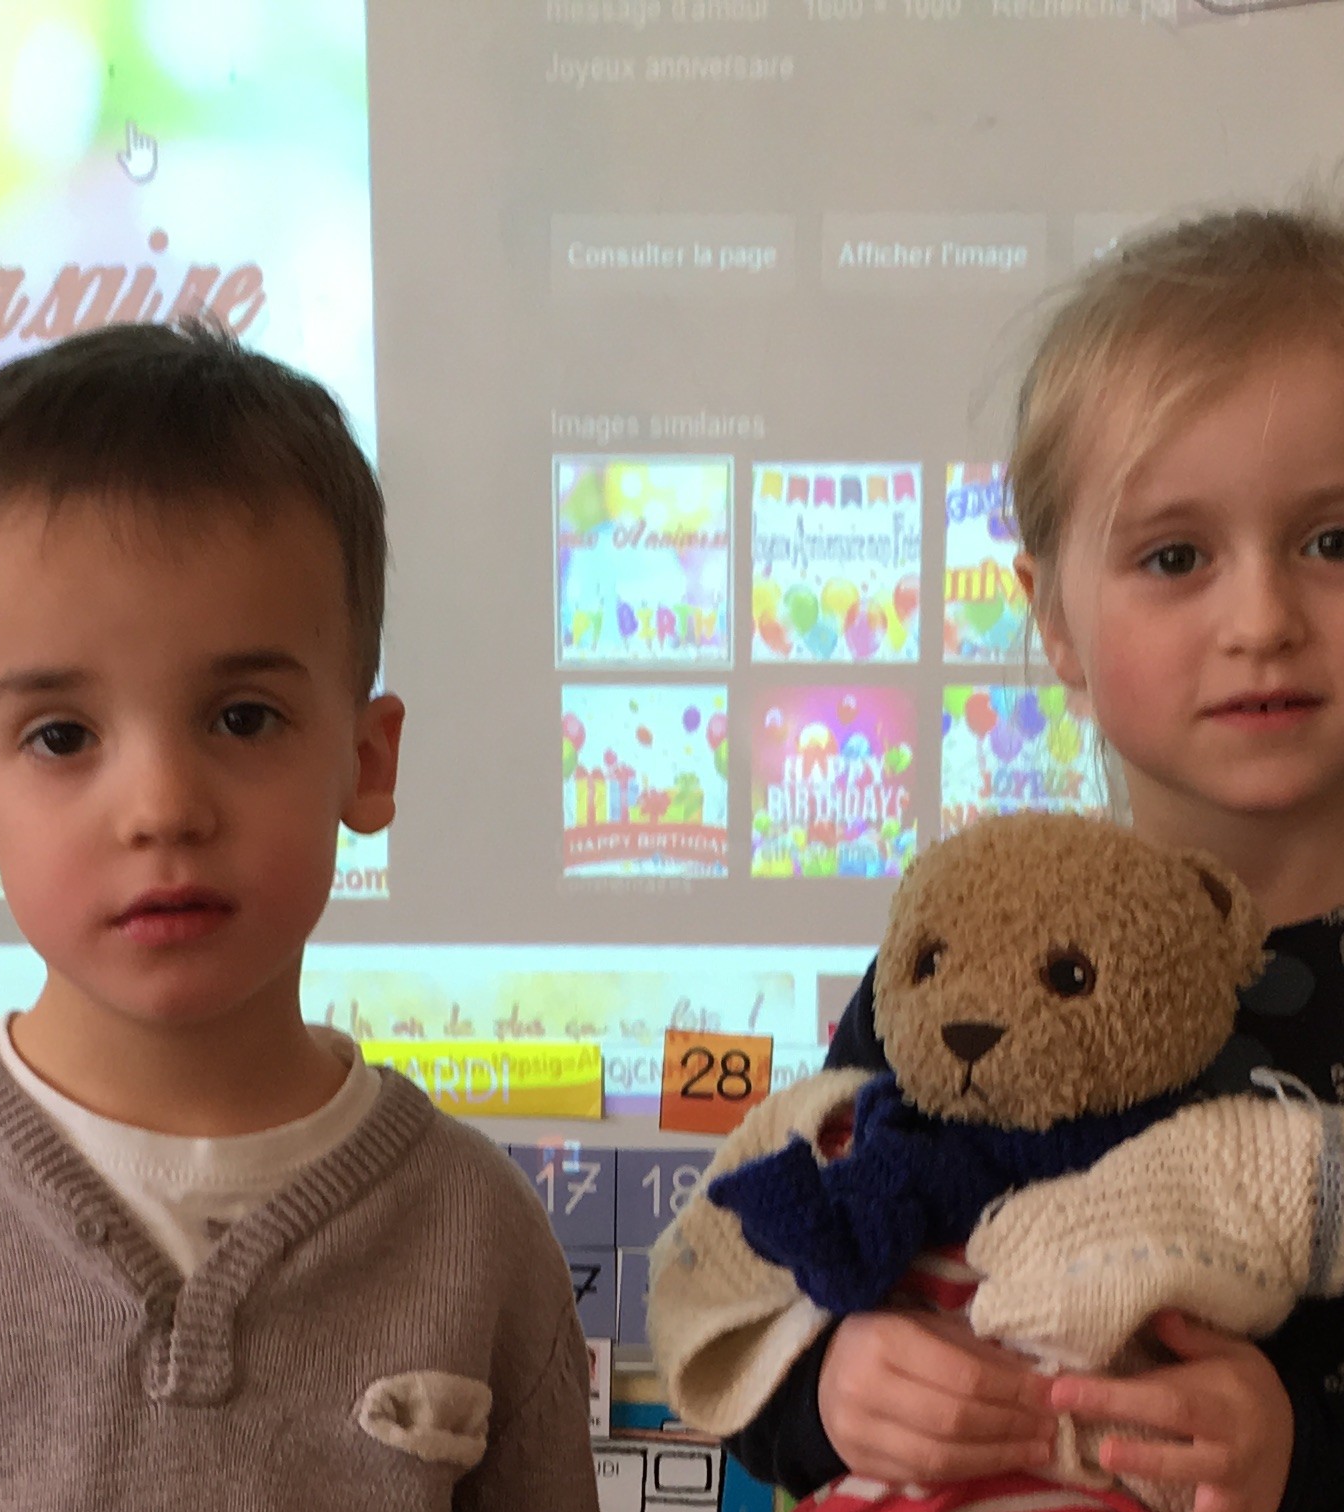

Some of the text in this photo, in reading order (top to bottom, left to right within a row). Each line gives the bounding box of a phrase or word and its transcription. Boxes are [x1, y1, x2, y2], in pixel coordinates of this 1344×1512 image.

[546, 50, 794, 88] Joyeux anniversaire
[567, 241, 777, 273] Consulter la page
[838, 240, 1028, 273] Afficher l'image
[551, 408, 766, 446] Images similaires
[680, 1046, 753, 1101] 28
[536, 1162, 601, 1216] 17
[641, 1165, 701, 1218] 18
